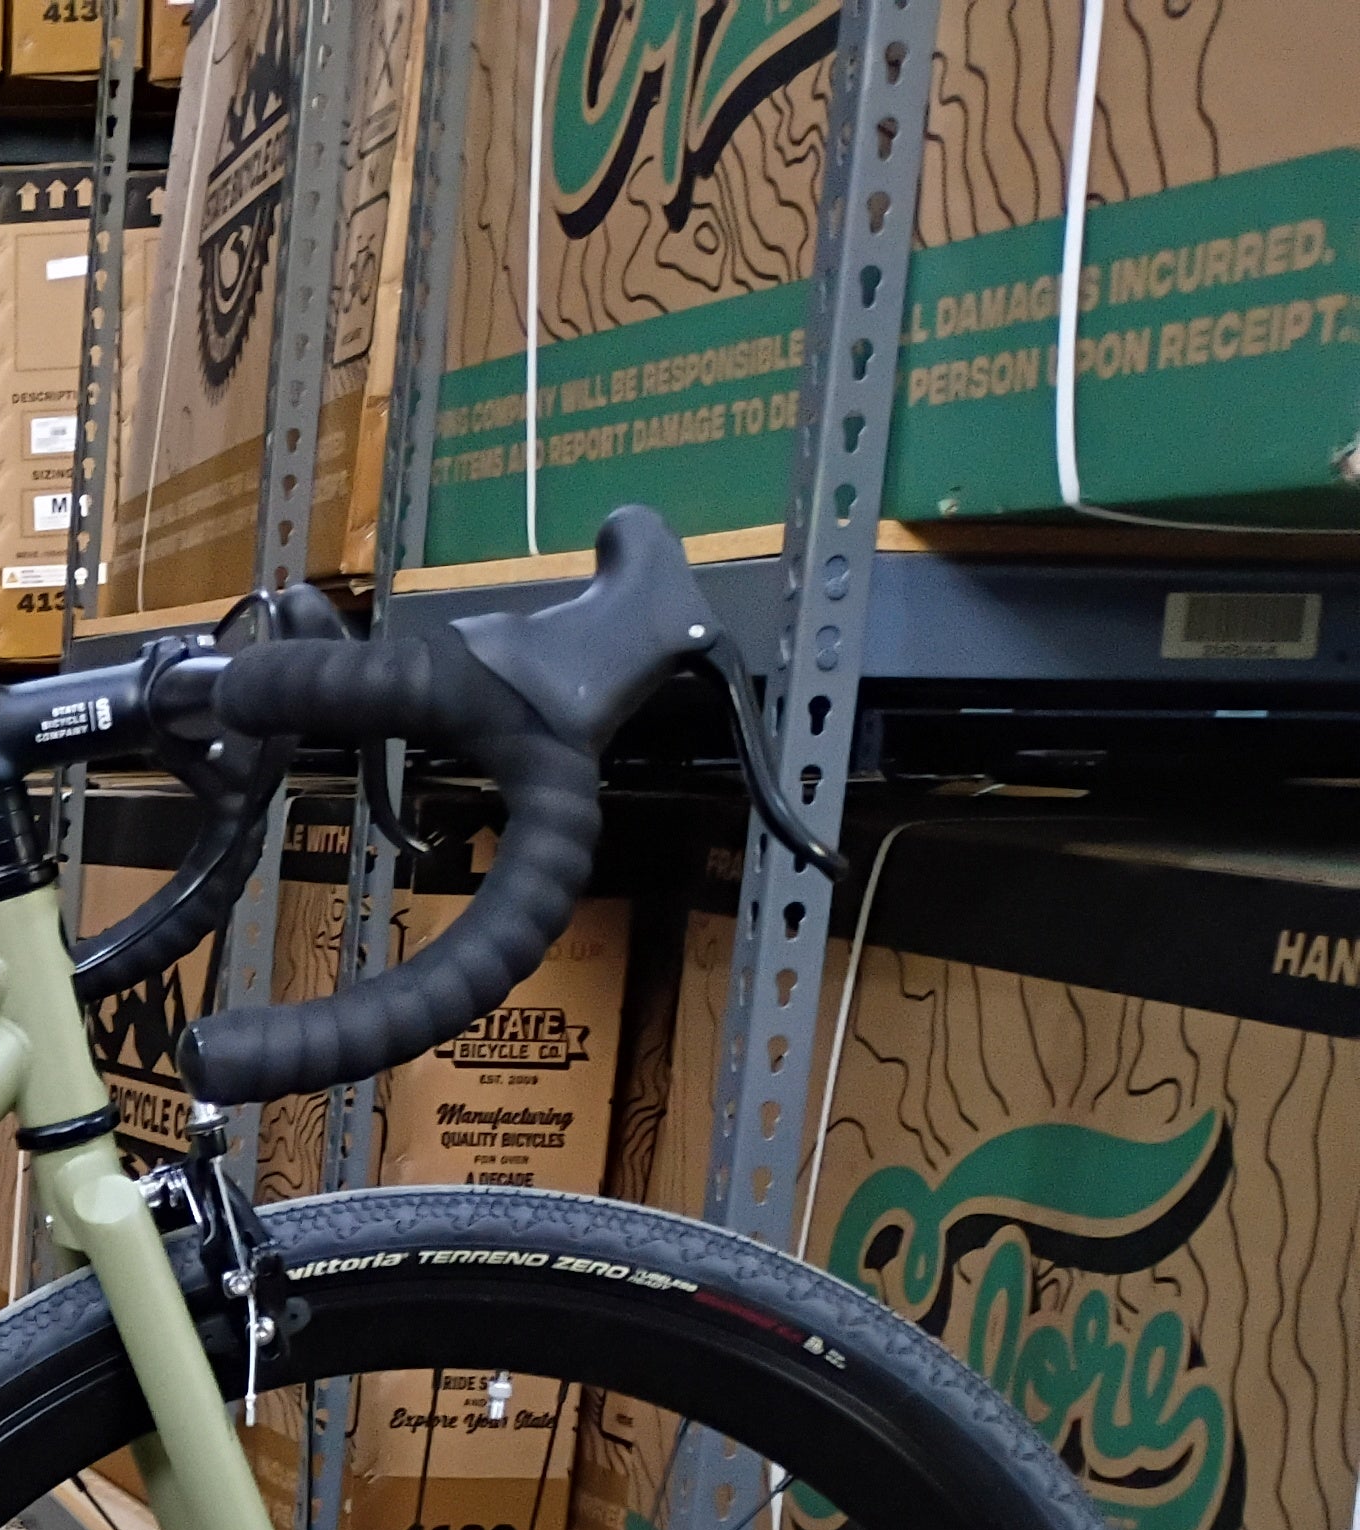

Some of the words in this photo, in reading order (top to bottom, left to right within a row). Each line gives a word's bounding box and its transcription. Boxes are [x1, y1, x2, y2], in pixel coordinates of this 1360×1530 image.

[1108, 218, 1336, 305] INCURRED.
[561, 372, 607, 414] WILL
[610, 366, 639, 403] BE
[643, 328, 806, 397] RESPONSIBLE
[907, 347, 1039, 408] PERSON
[549, 422, 629, 467] REPORT
[632, 403, 726, 455] DAMAGE
[732, 396, 766, 437] TO
[51, 497, 68, 514] M
[306, 824, 351, 855] WITH
[1272, 929, 1360, 987] HAN
[459, 1043, 529, 1059] BICYCLE
[109, 1084, 172, 1136] BICYCLE
[437, 1102, 575, 1132] Manufacturing
[441, 1131, 498, 1150] QUALITY
[501, 1131, 566, 1149] BICYCLES
[465, 1171, 475, 1185] A
[287, 1252, 406, 1282] vittoria
[417, 1249, 551, 1269] TERRENO
[551, 1253, 631, 1281] ZERO
[442, 1375, 476, 1391] RIDE
[389, 1407, 459, 1434] Explore
